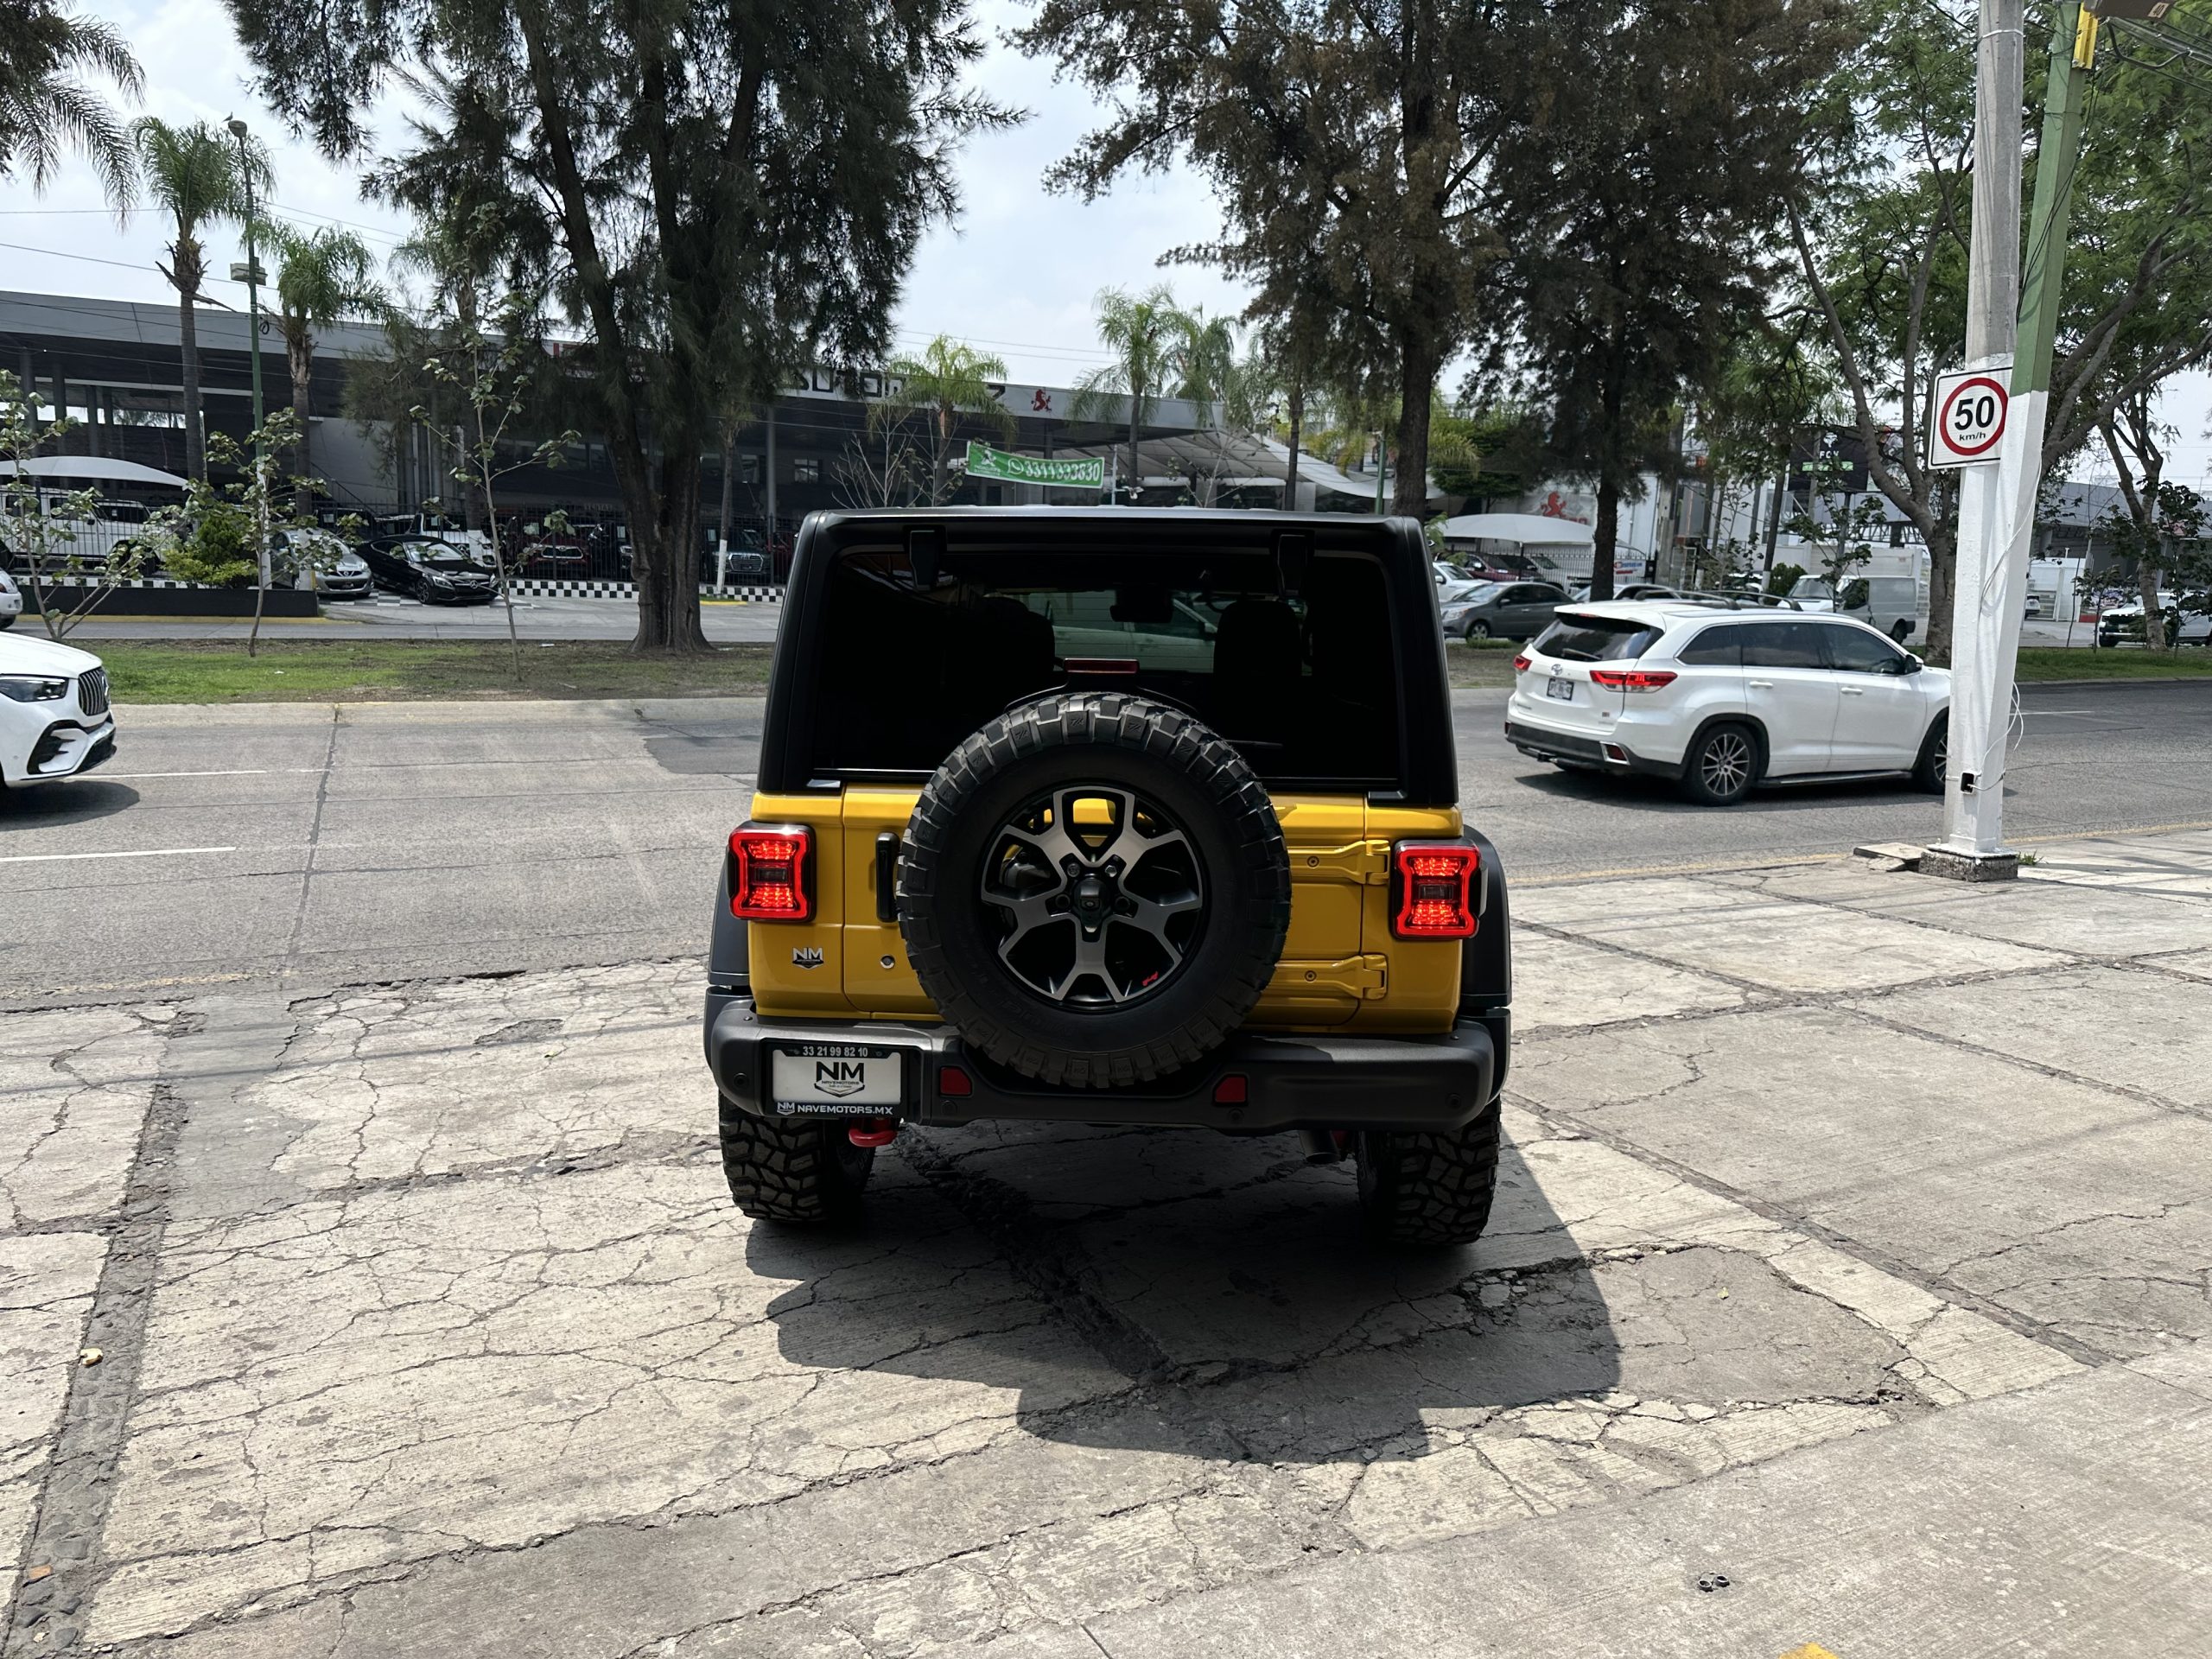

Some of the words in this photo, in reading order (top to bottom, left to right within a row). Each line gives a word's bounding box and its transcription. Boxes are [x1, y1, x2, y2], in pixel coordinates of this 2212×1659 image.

[1955, 396, 1994, 430] 50
[1959, 432, 1986, 441] km/h
[792, 947, 823, 961] NM
[803, 1046, 814, 1056] 33
[817, 1046, 828, 1056] 21
[830, 1046, 842, 1057] 99
[843, 1046, 855, 1057] 82
[858, 1047, 868, 1058] 10
[817, 1061, 864, 1084] NM
[798, 1105, 893, 1115] NAVEMOTORS.MX
